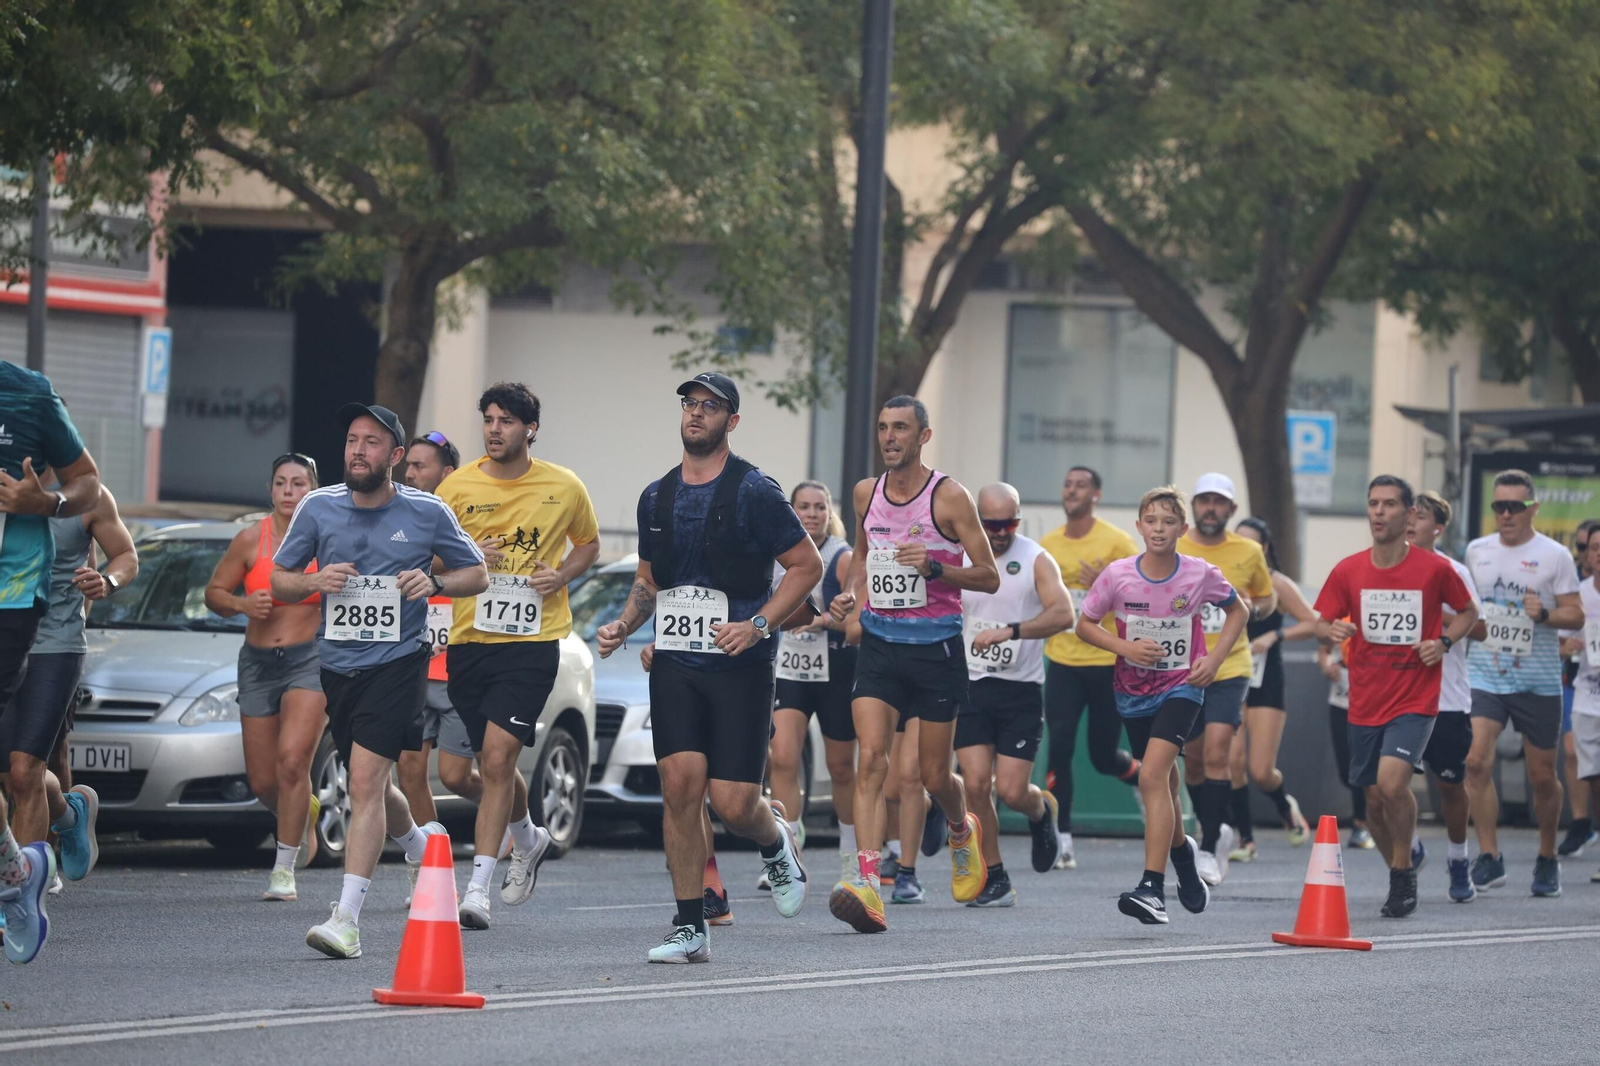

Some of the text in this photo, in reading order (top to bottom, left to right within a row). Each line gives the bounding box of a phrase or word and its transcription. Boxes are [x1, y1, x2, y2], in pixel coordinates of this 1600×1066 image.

[1291, 421, 1325, 466] P
[872, 574, 920, 594] 8637
[333, 604, 395, 627] 2885
[483, 599, 538, 623] 1719
[1368, 613, 1418, 631] 5729
[663, 614, 722, 639] 2815
[781, 651, 824, 671] 2034
[86, 746, 125, 769] DVH
